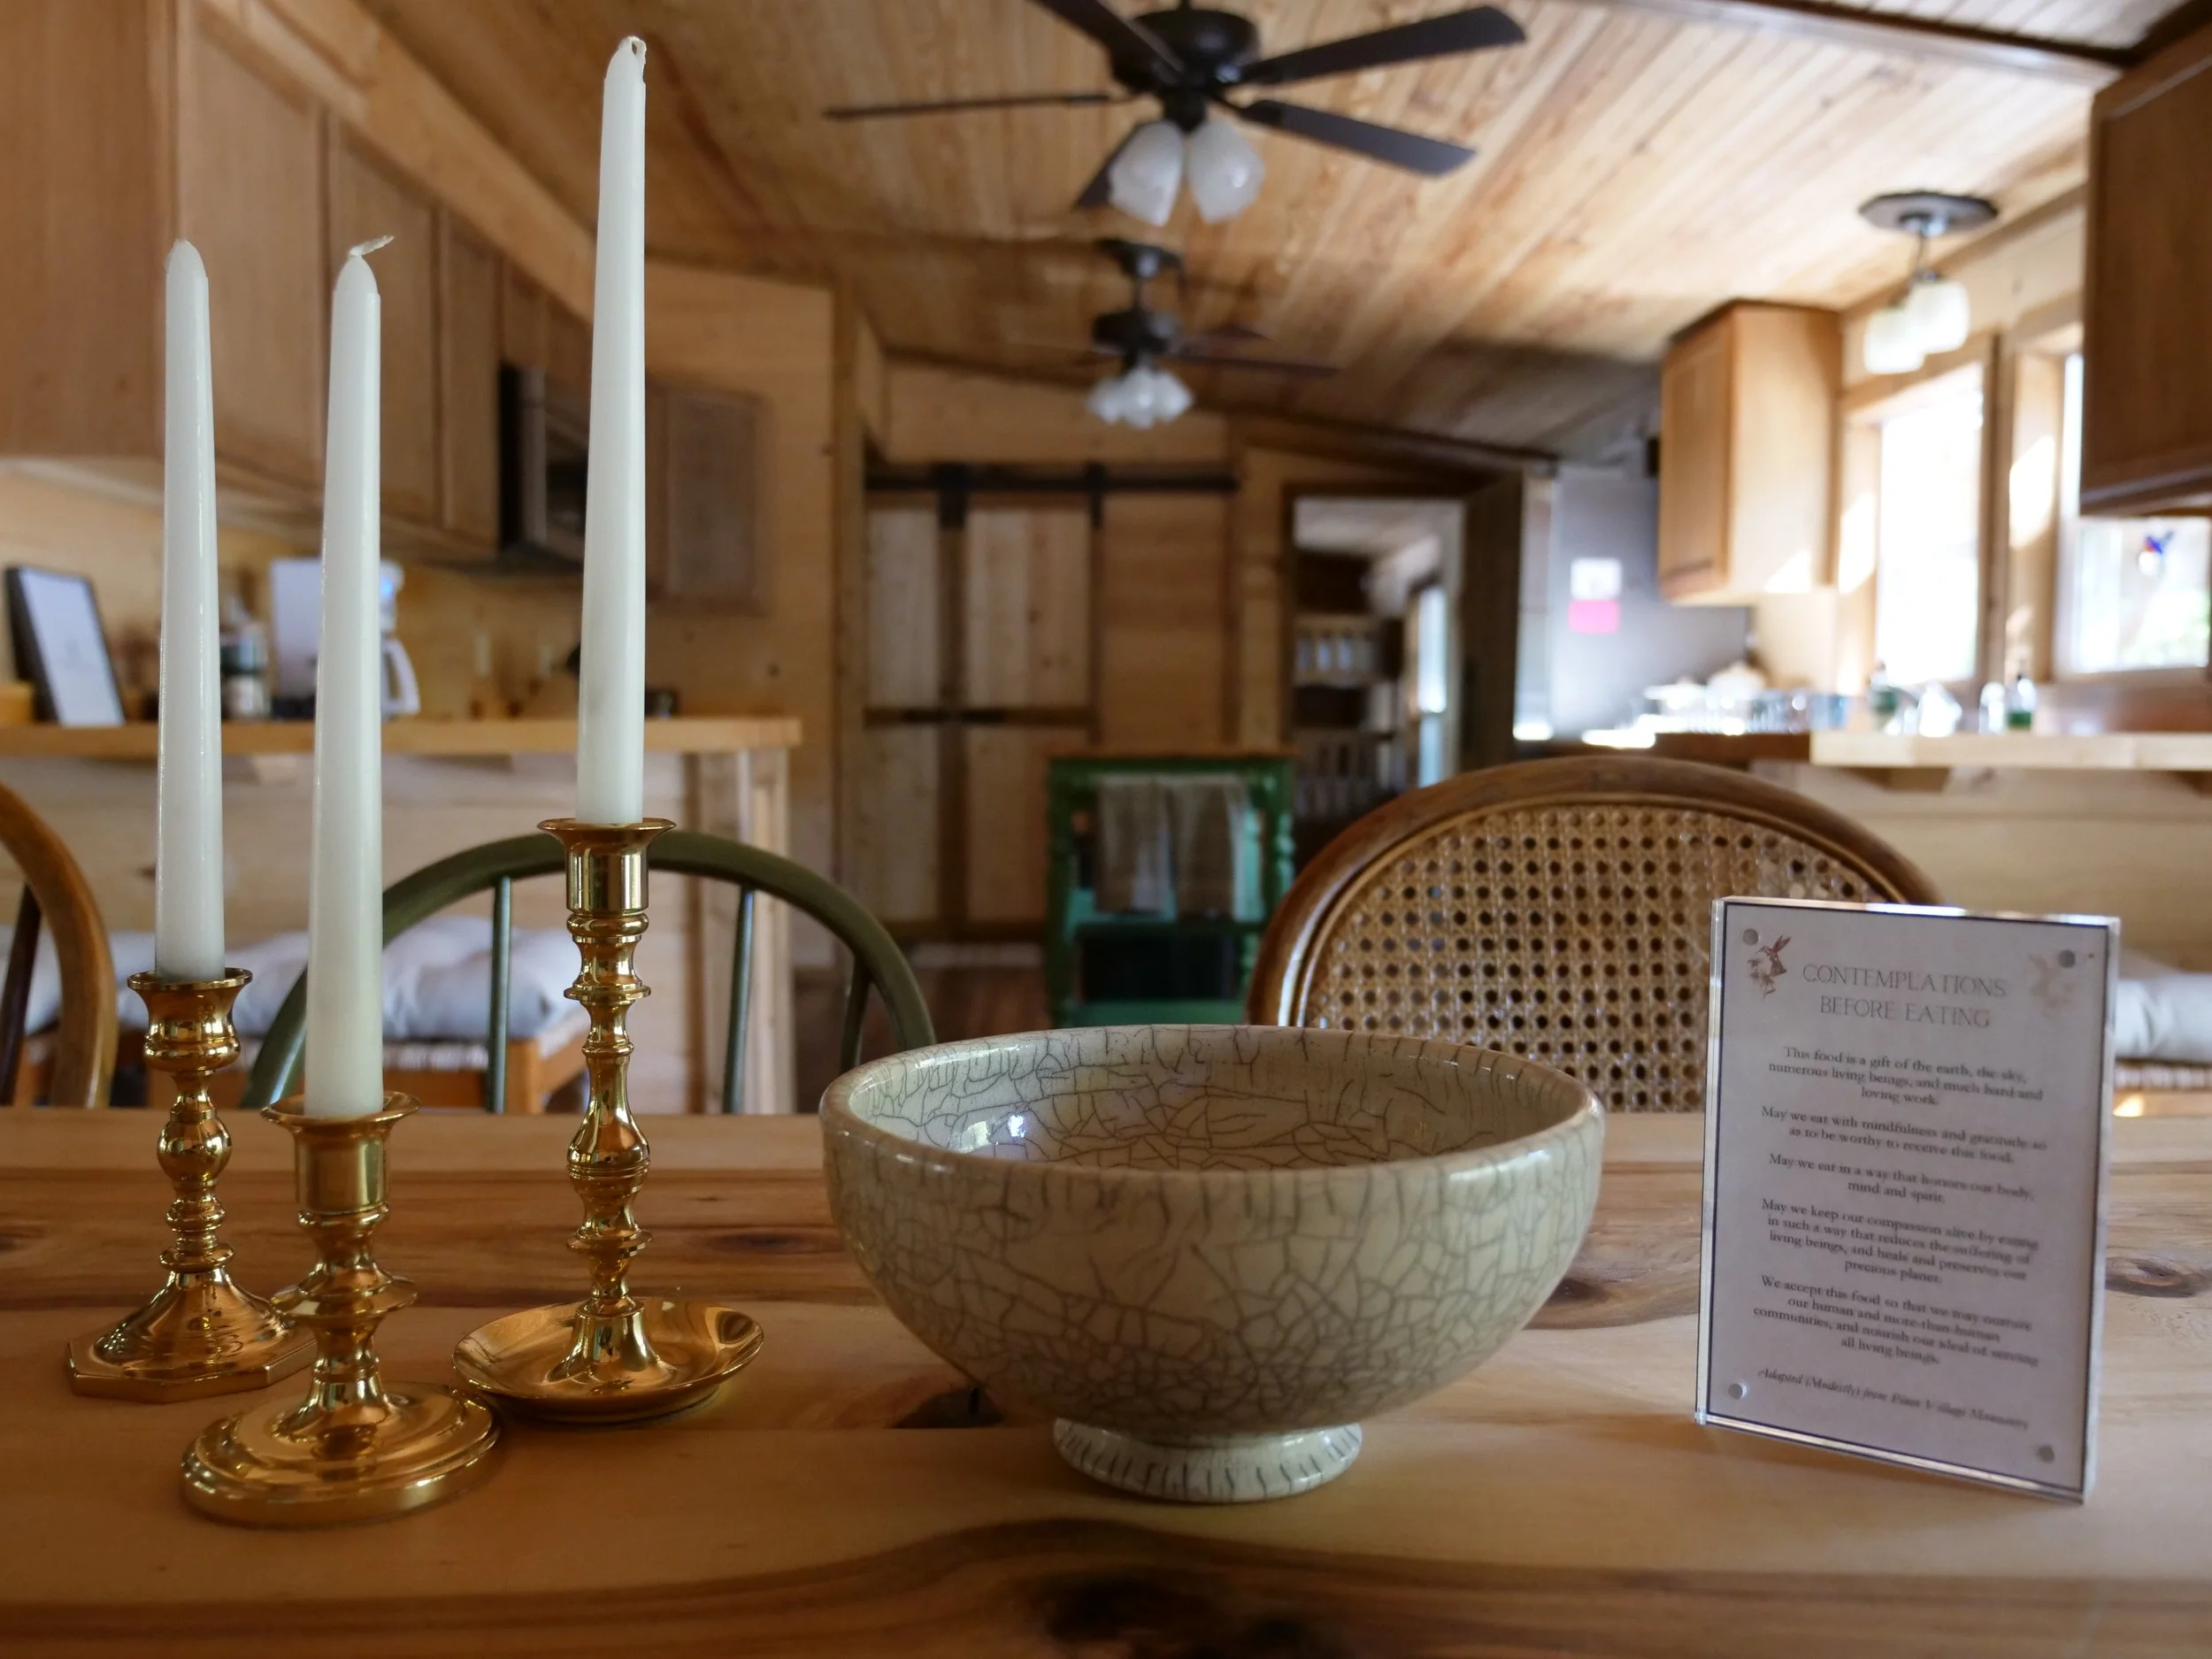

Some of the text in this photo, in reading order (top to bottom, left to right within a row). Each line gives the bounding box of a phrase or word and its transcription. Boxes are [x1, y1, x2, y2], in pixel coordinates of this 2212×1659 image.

[1802, 963, 2008, 997] CONTEMPLATIONS
[1820, 995, 1990, 1028] BEFORE EATING
[1769, 1063, 2043, 1102] numerous living beings, and much hard and
[1784, 1046, 2026, 1084] This food is a gift of the earth, the sky,
[1862, 1087, 1939, 1105] loving work.
[1762, 1106, 2047, 1150] May we eat with mindfulness and gratitude so
[1789, 1127, 2014, 1164] as to be worthy to receive this food.
[1770, 1154, 1794, 1169] May
[1798, 1160, 1814, 1170] we
[1818, 1163, 1835, 1171] eat
[1839, 1164, 1851, 1174] in
[1865, 1170, 1888, 1181] way
[1893, 1171, 1917, 1183] that
[1921, 1174, 1968, 1190] honors
[1970, 1183, 1993, 1193] our
[1848, 1181, 1946, 1203] mind and spirit.
[1762, 1198, 1787, 1214] May
[1791, 1205, 1807, 1215] we
[1811, 1205, 1839, 1222] keep
[1843, 1213, 1863, 1224] our
[1868, 1217, 1941, 1234] compassion
[1946, 1226, 1975, 1239] alive
[1979, 1230, 1994, 1244] by
[1768, 1215, 2030, 1264] in such a way that reduces the suffering of
[1770, 1231, 1801, 1247] living
[1806, 1237, 1847, 1254] beings,
[1851, 1246, 1873, 1256] and
[1878, 1248, 1908, 1263] heals
[1912, 1256, 1935, 1266] and
[1939, 1259, 2000, 1276] preserves
[1845, 1260, 1942, 1283] precious planet.
[1762, 1275, 1780, 1287] We
[1785, 1282, 1822, 1297] accept
[1826, 1286, 1847, 1299] this
[1852, 1291, 1880, 1305] food
[1902, 1300, 1926, 1313] that
[1931, 1307, 1949, 1317] we
[1953, 1310, 1979, 1324] may
[1788, 1299, 1809, 1309] our
[1812, 1300, 1854, 1316] human
[1859, 1310, 1880, 1321] and
[1754, 1308, 1832, 1331] communities,
[1836, 1323, 1858, 1333] and
[1863, 1326, 1909, 1342] nourish
[1912, 1337, 1935, 1347] our
[1939, 1340, 1969, 1353] ideal
[1972, 1346, 1987, 1356] of
[1841, 1337, 1855, 1348] all
[1859, 1340, 1893, 1357] living
